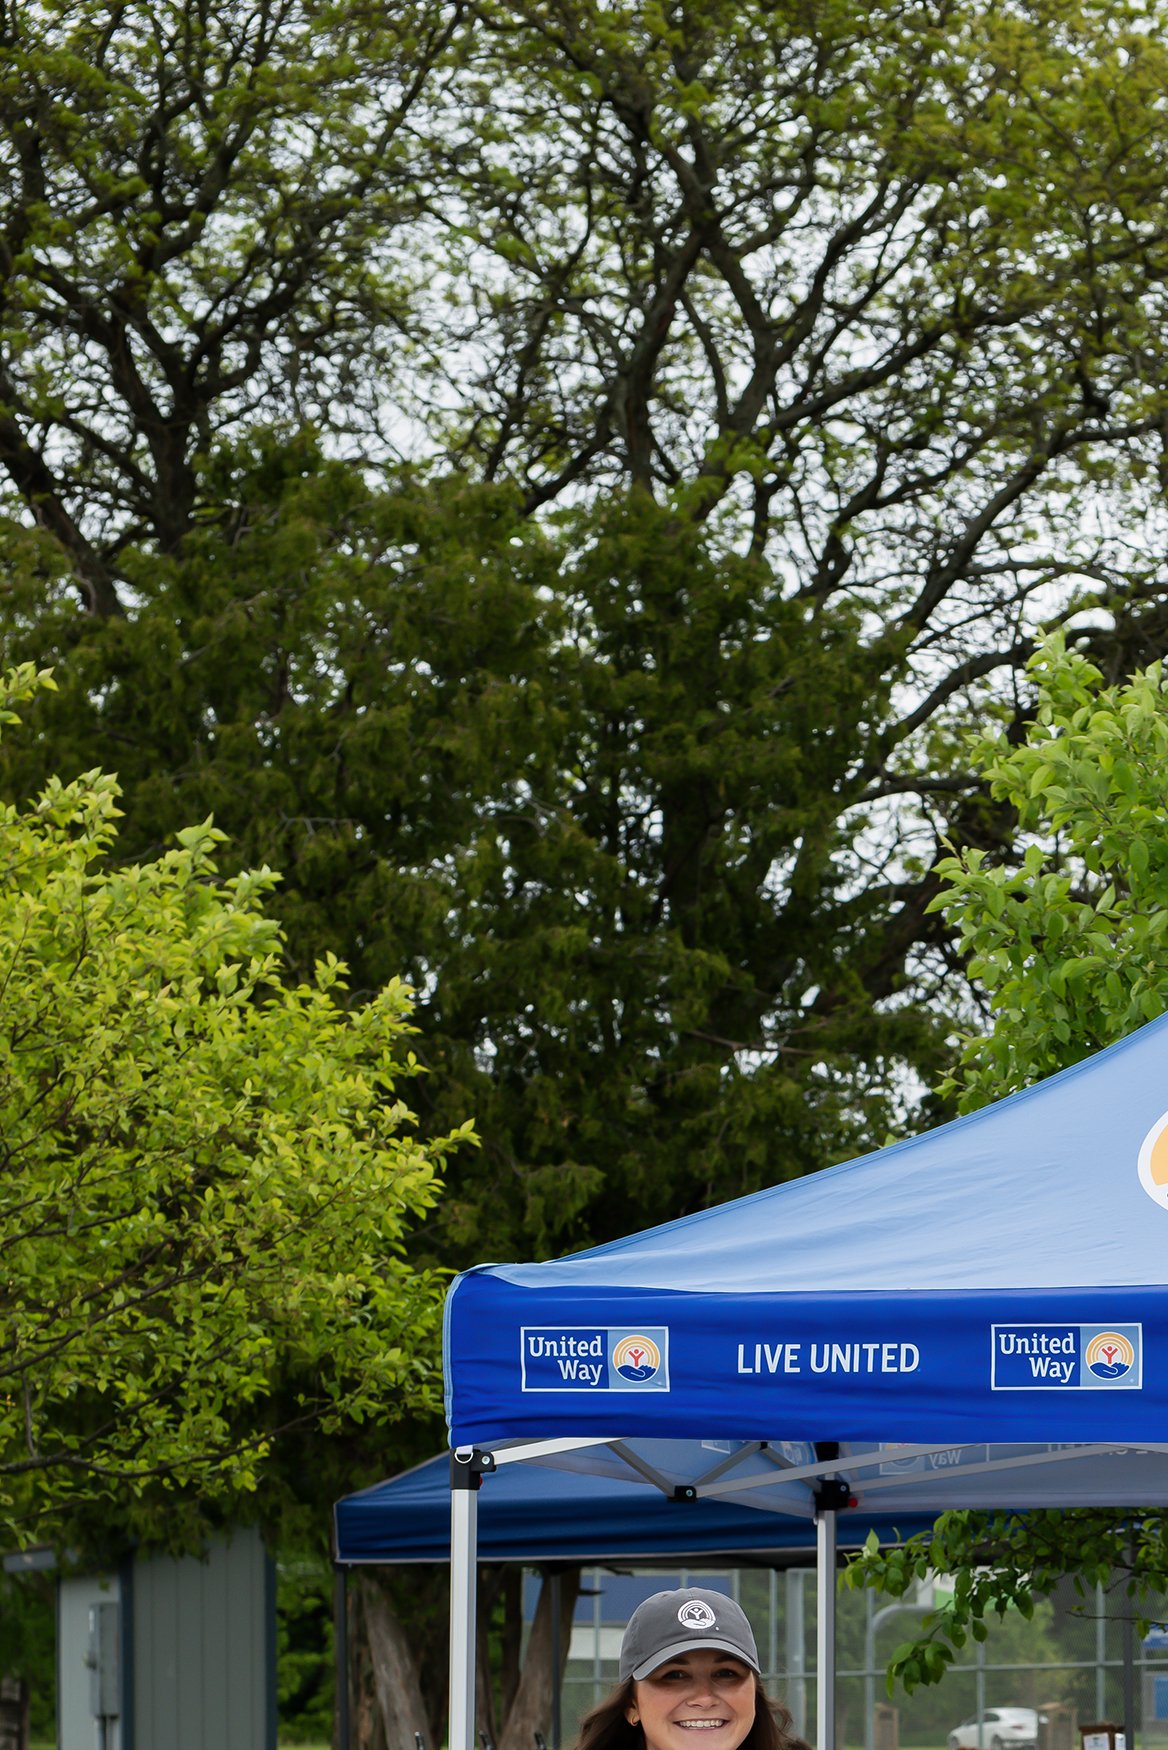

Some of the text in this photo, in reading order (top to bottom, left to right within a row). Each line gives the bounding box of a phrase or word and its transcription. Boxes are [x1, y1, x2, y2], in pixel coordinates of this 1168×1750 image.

[528, 1335, 603, 1358] United
[737, 1343, 920, 1374] LIVE UNITED
[999, 1333, 1077, 1357] United
[557, 1359, 603, 1386] Way
[1029, 1356, 1077, 1384] Way
